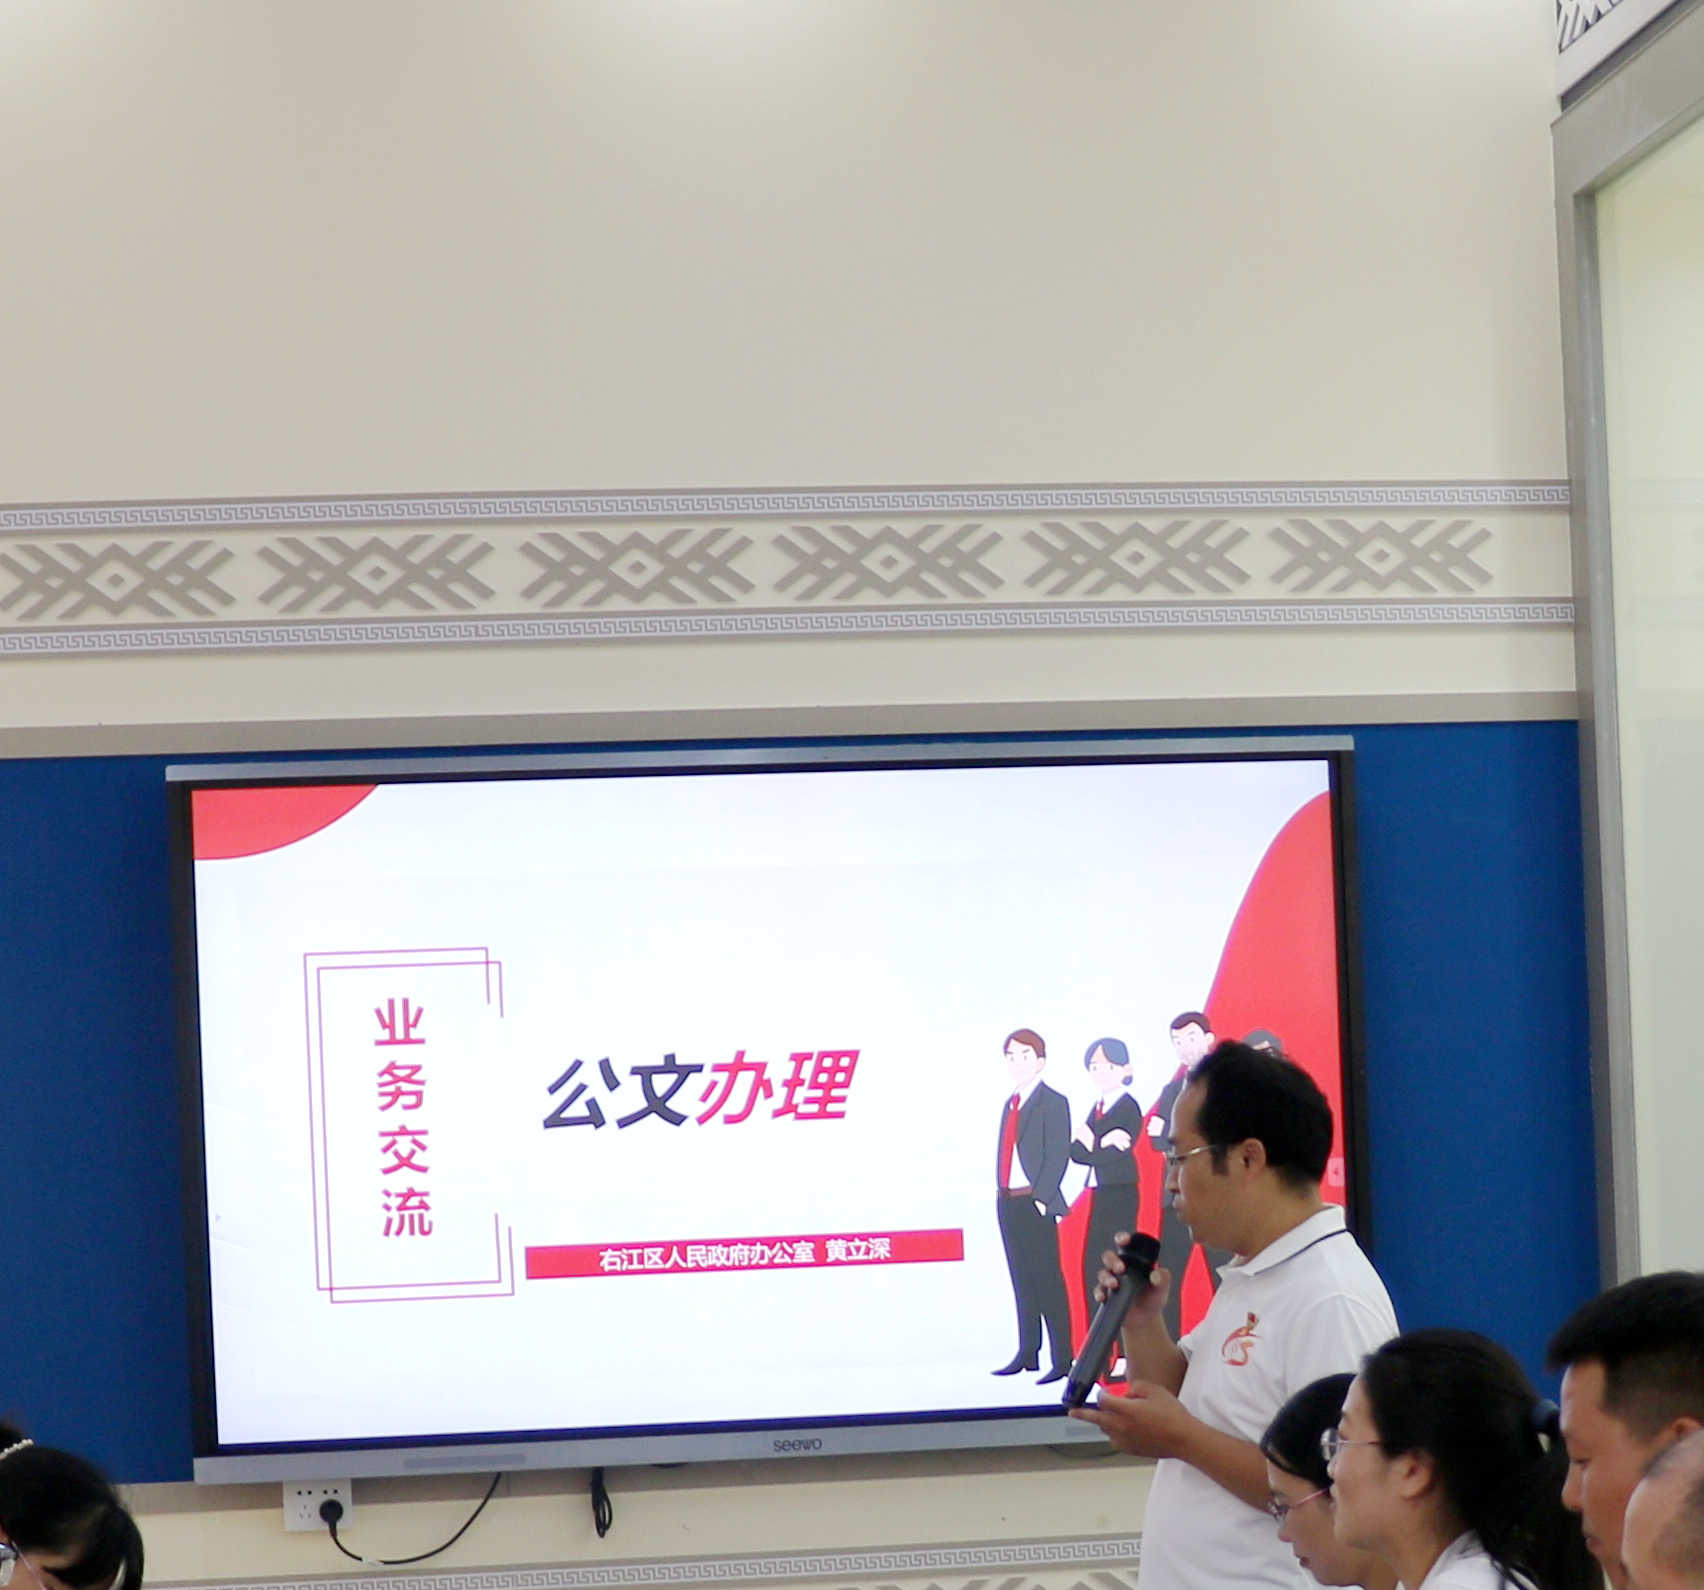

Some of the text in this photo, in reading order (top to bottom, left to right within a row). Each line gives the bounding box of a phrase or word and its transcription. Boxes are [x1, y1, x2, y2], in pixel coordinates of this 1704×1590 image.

[374, 997, 434, 1237] 业务交流
[543, 1049, 861, 1129] 公文办理
[599, 1237, 891, 1272] 右江区人民政府办公室 黄立深
[773, 1438, 823, 1452] seewo
